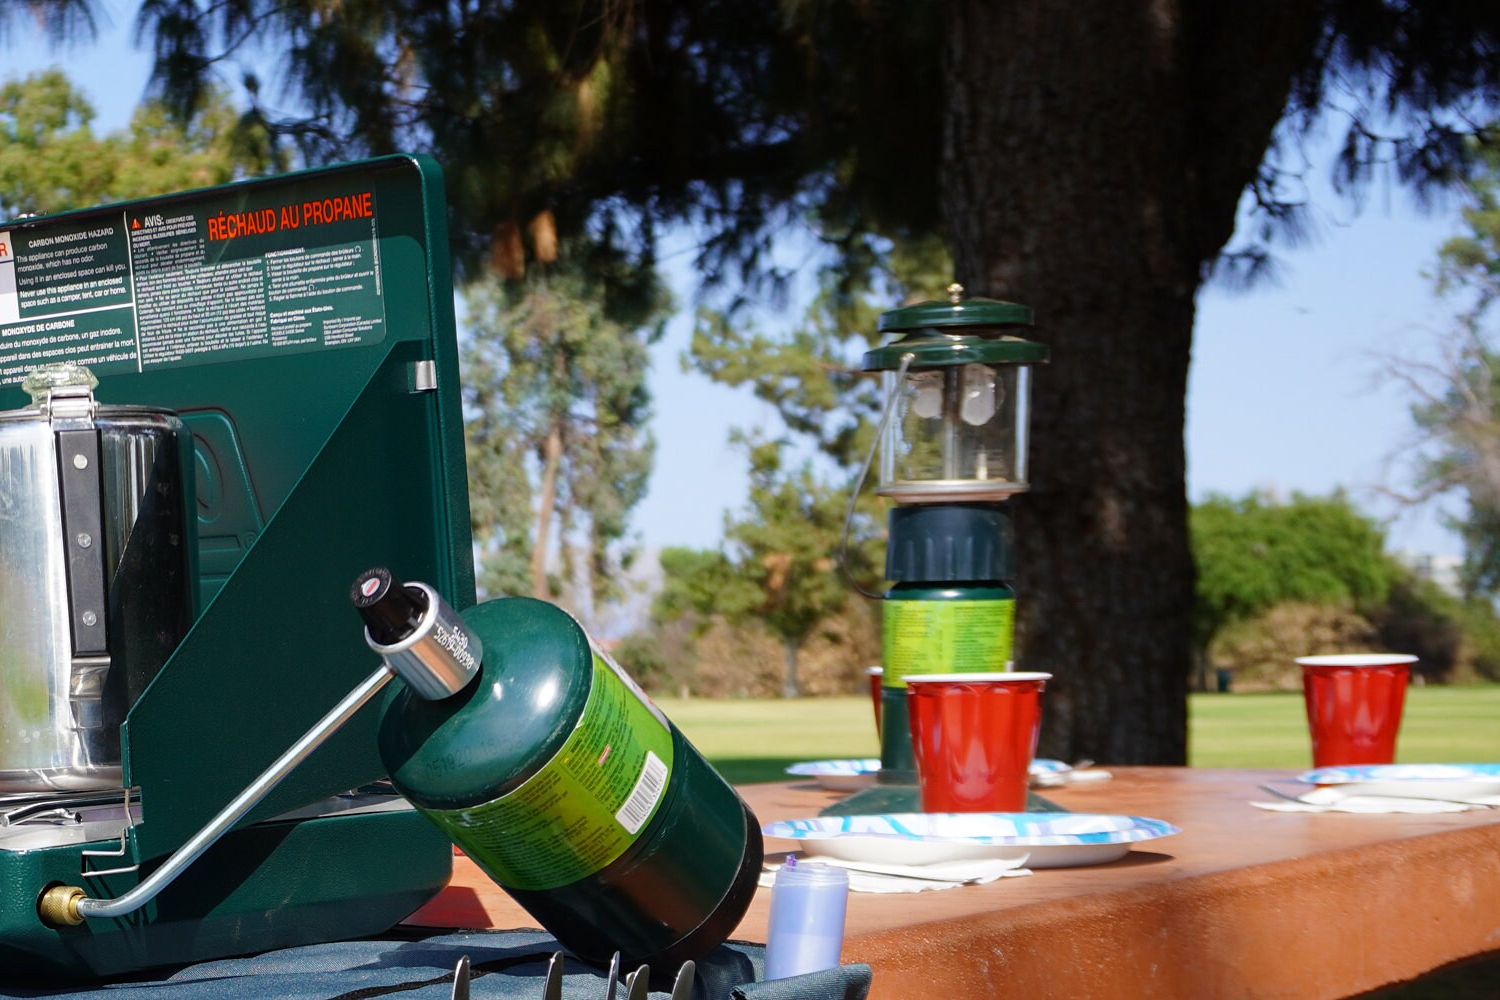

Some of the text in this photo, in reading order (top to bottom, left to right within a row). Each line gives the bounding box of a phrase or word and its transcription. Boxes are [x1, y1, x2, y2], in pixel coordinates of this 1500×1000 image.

[143, 214, 164, 227] AVIS:
[208, 192, 373, 241] RÉCHAUD AU PROPANE
[28, 227, 113, 247] CARBON MONOXIDE HAZARD
[16, 254, 27, 262] This
[28, 250, 53, 262] appliance
[65, 245, 87, 256] produce
[88, 242, 107, 252] carbon
[45, 259, 61, 268] which
[61, 258, 71, 266] has
[80, 254, 94, 263] odor.
[18, 276, 34, 286] Using
[39, 274, 44, 282] in
[52, 269, 76, 280] enclosed
[77, 268, 93, 277] space
[114, 263, 127, 272] you.
[19, 289, 35, 298] Never
[36, 288, 46, 296] use
[46, 286, 56, 294] this
[57, 282, 82, 294] appliance
[83, 281, 89, 289] in
[97, 276, 122, 286] enclosed
[20, 300, 36, 309] space
[37, 297, 49, 305] such
[60, 293, 81, 303] camper,
[81, 290, 93, 299] tent,
[109, 285, 126, 294] home.
[1, 319, 75, 337] MONOXYDE DE CARBONE
[13, 339, 20, 348] du
[21, 335, 48, 348] monoxyde
[49, 335, 56, 343] de
[57, 332, 80, 343] carbone,
[89, 330, 99, 339] gaz
[99, 326, 122, 337] inodore.
[17, 351, 31, 360] dans
[32, 350, 41, 358] des
[42, 348, 64, 359] espaces
[64, 345, 75, 354] clos
[76, 343, 89, 354] peut
[113, 339, 119, 347] la
[120, 337, 135, 347] mort.
[2, 365, 23, 376] appareil
[77, 357, 97, 366] comme
[129, 350, 137, 358] de
